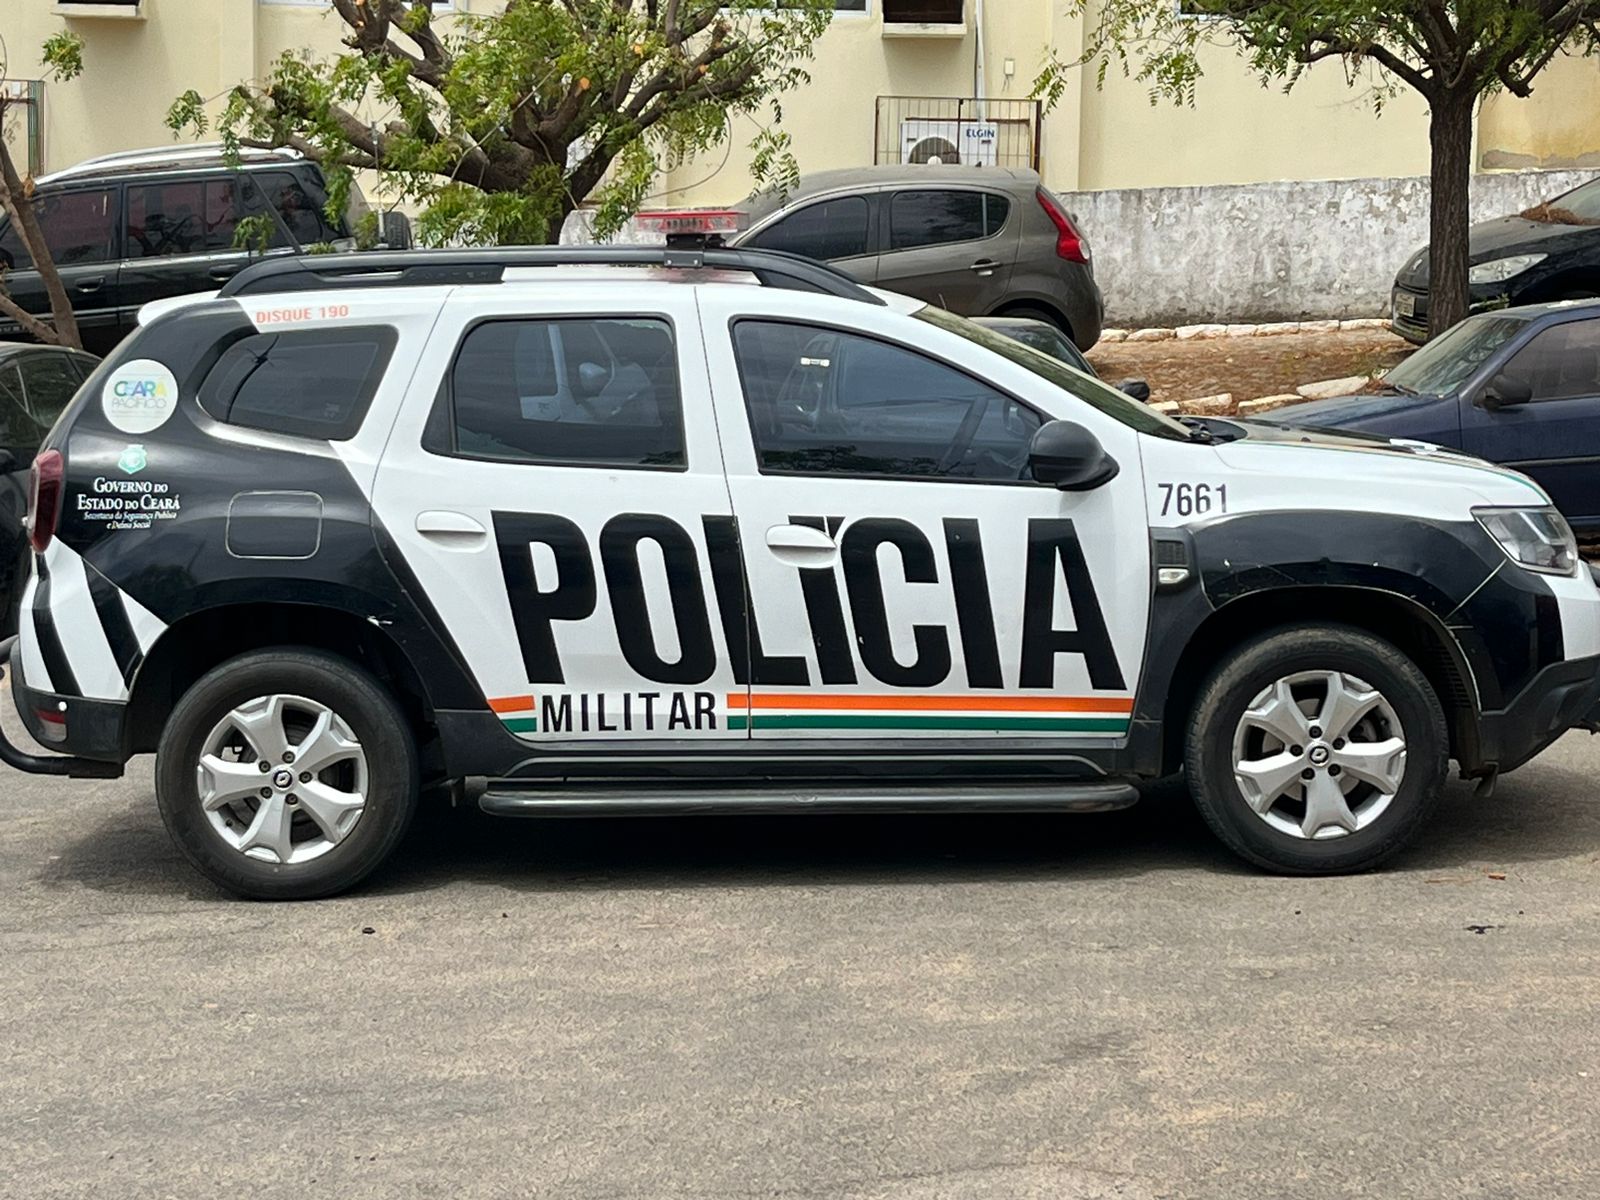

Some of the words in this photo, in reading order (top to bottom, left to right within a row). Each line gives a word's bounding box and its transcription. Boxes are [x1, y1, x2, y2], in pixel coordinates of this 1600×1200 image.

[966, 129, 995, 138] ELGIN
[256, 308, 312, 323] DISQUE
[319, 304, 349, 318] 190
[1158, 483, 1227, 516] 7661
[541, 691, 717, 733] MILITAR
